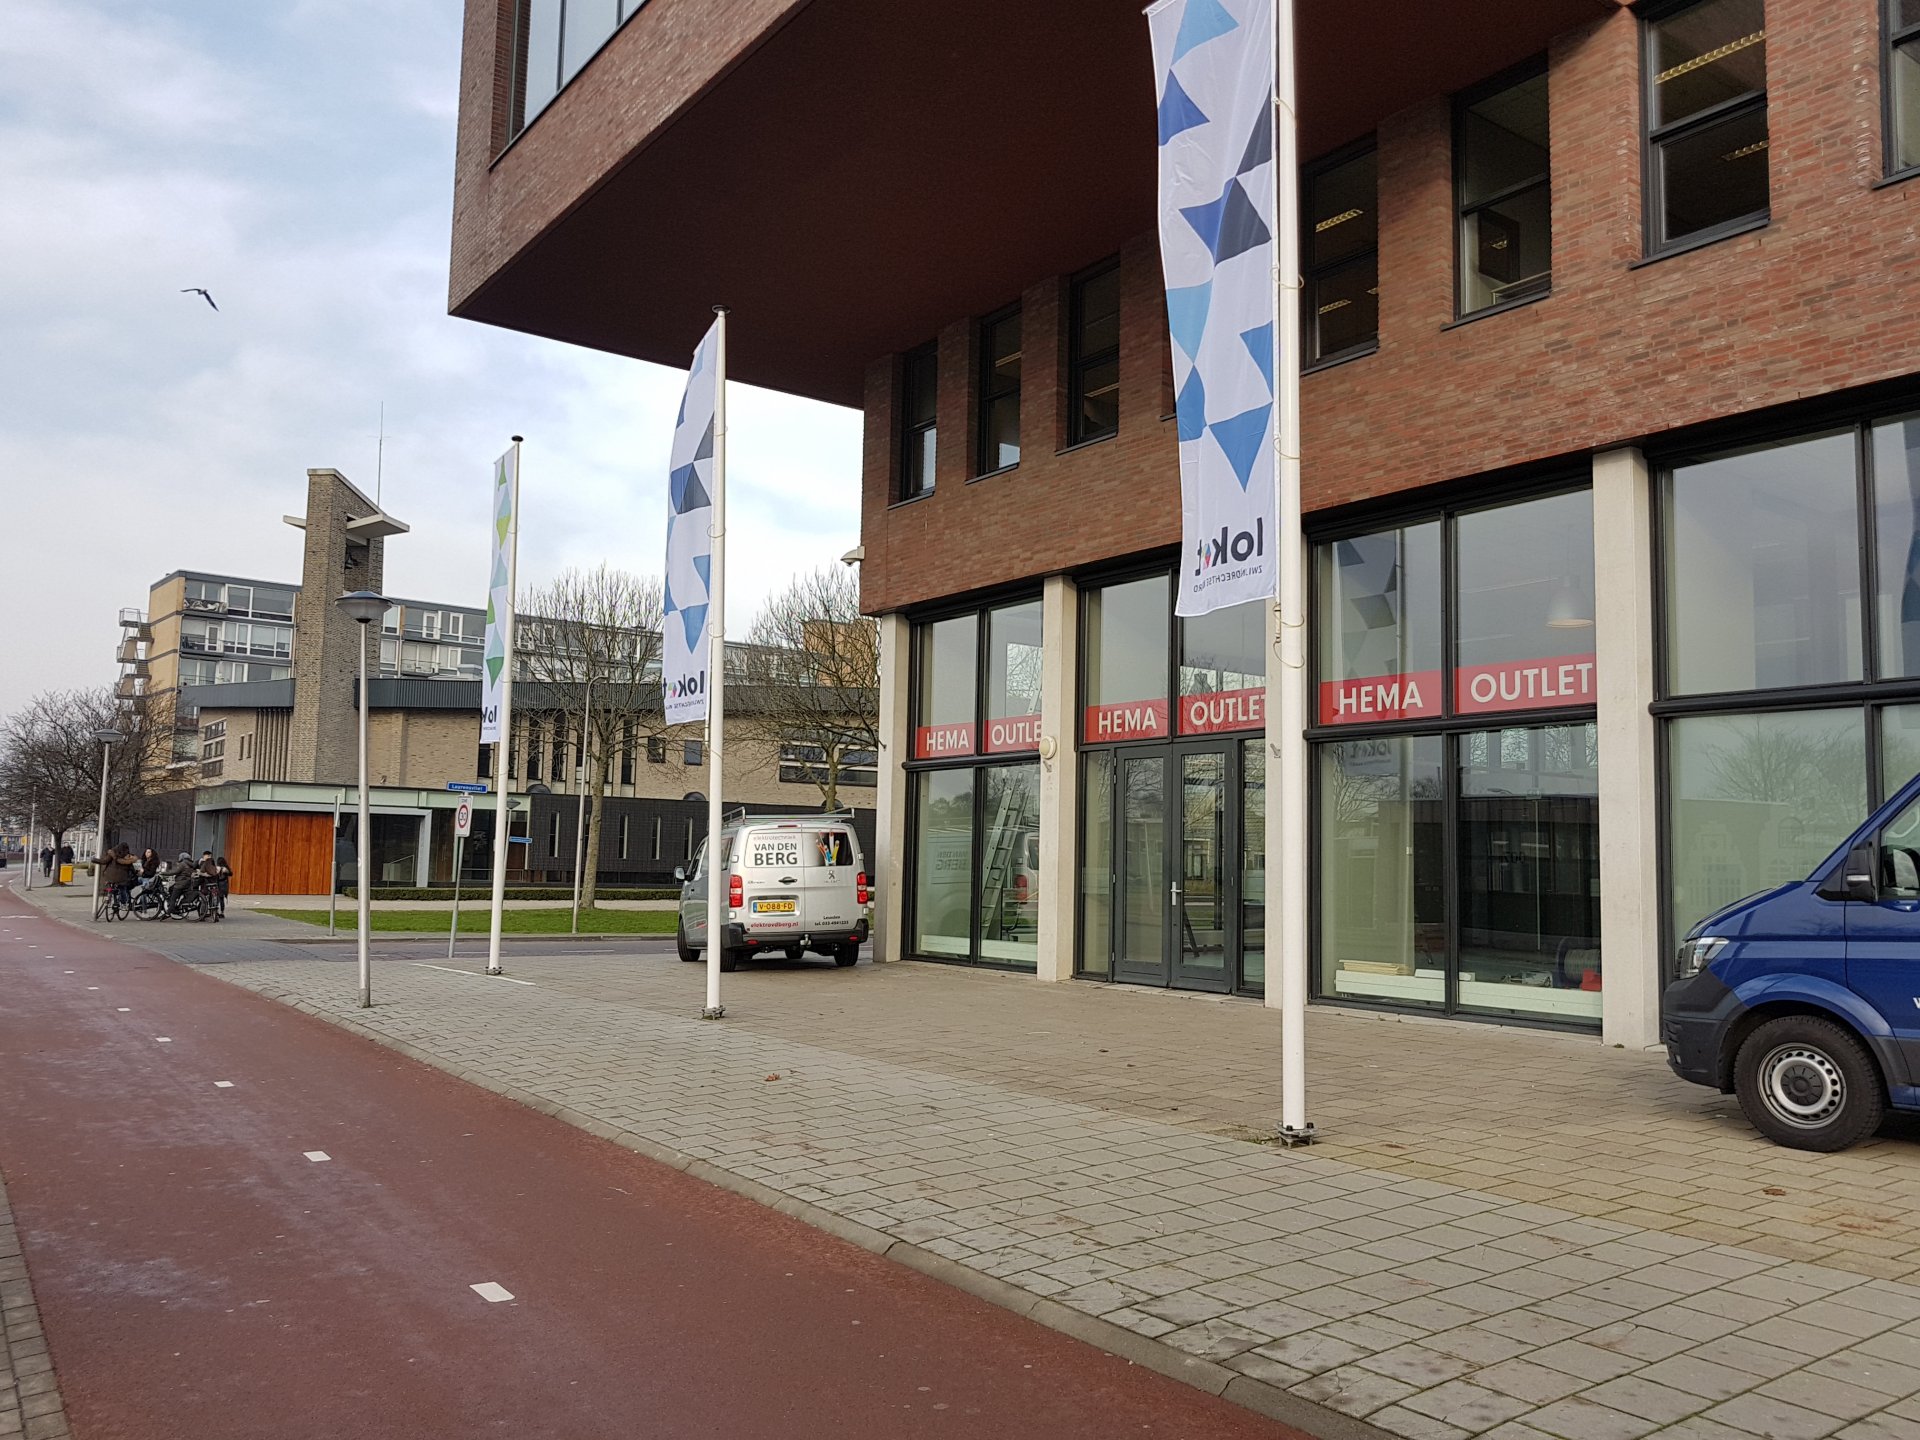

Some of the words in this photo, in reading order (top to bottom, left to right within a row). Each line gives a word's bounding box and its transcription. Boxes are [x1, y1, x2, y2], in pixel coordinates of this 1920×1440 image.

[1338, 680, 1423, 716] HEMA
[1470, 662, 1593, 704] OUTLET
[1098, 706, 1157, 734] HEMA
[926, 728, 969, 752] HEMA
[992, 720, 1042, 746] OUTLE
[754, 843, 775, 851] VAN
[777, 842, 797, 851] DEN
[754, 852, 798, 866] BERG
